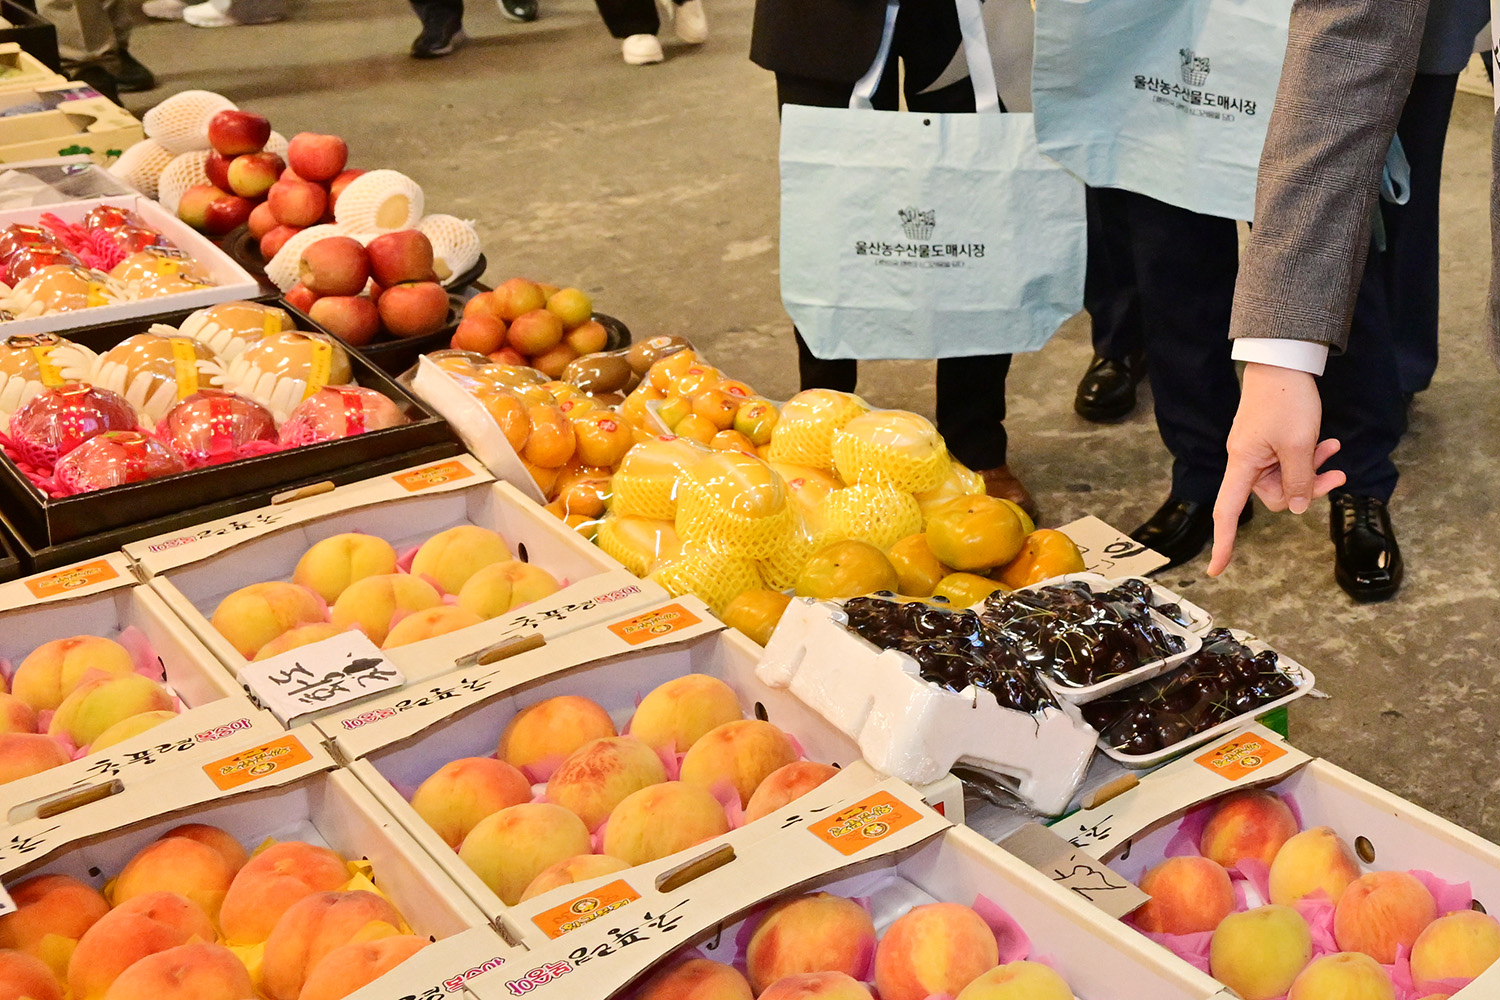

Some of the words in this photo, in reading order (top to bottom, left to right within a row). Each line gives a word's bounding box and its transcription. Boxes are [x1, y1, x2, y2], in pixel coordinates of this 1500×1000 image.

[1134, 74, 1257, 116] 울산농수산물도매시장
[855, 240, 986, 258] 울산농수산물도매시장
[505, 957, 574, 997] 복숭아
